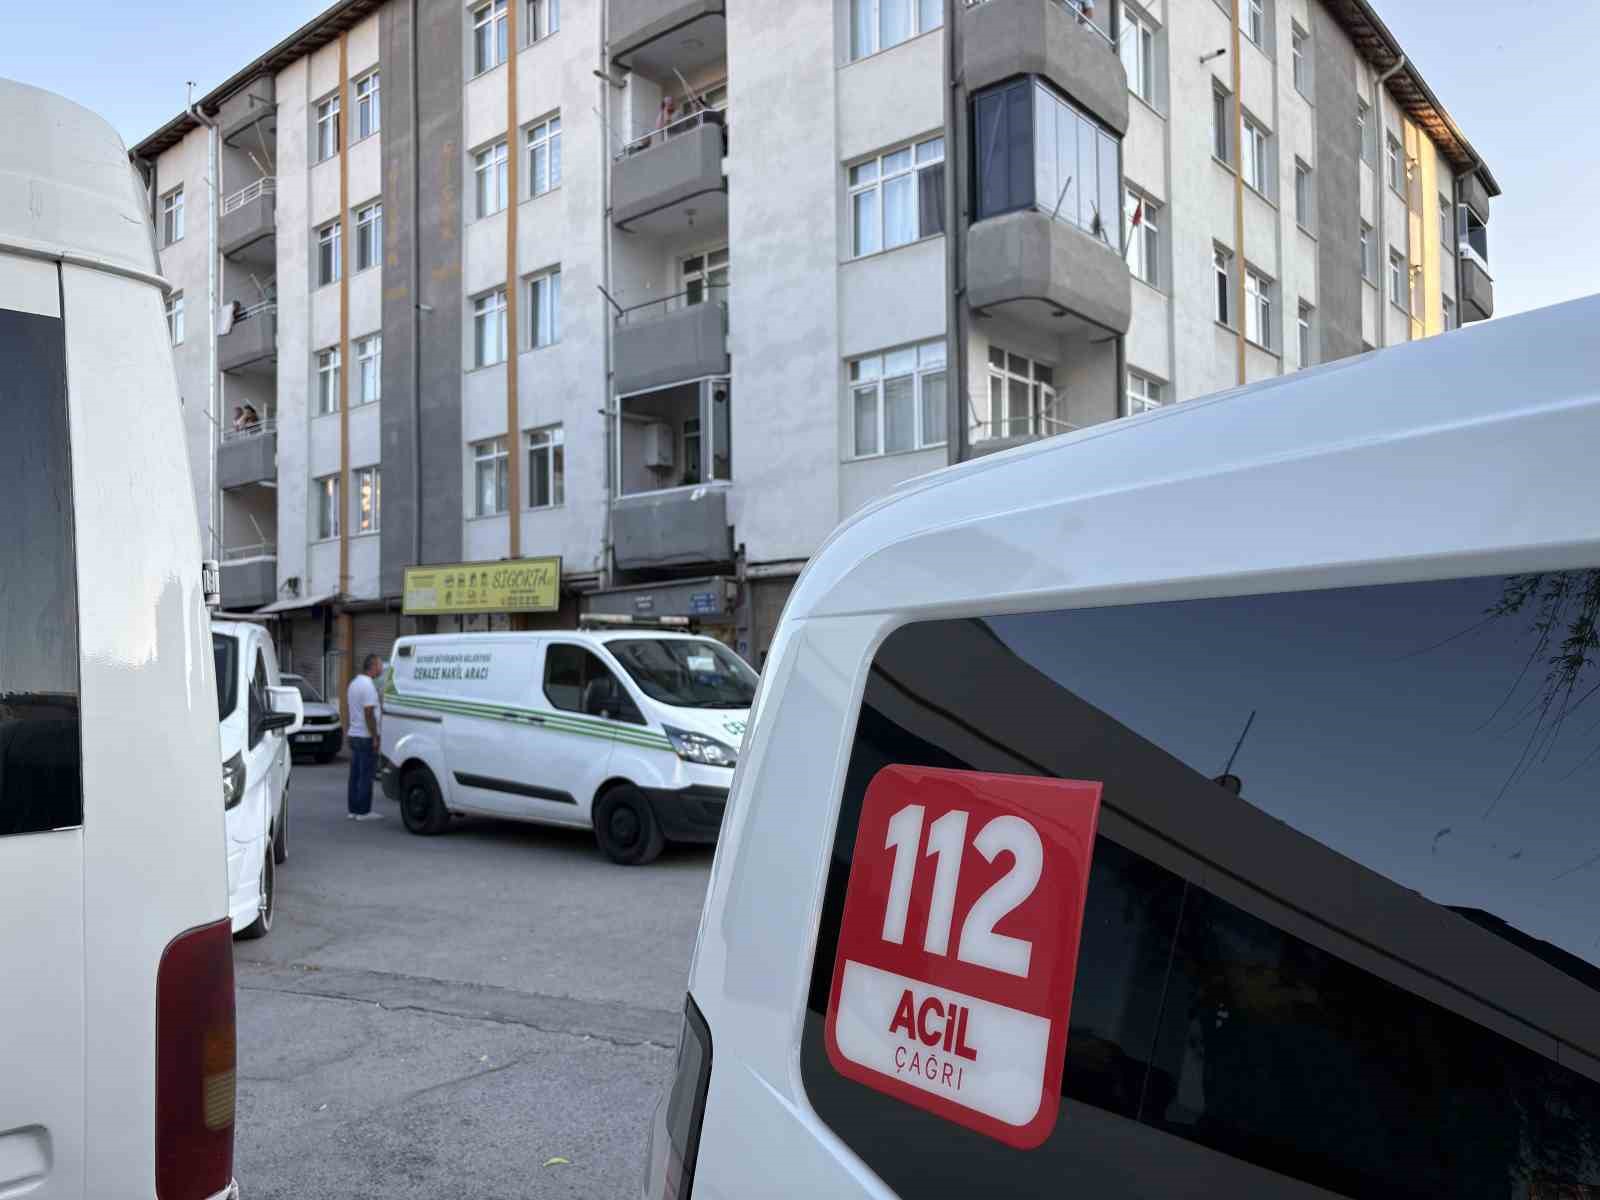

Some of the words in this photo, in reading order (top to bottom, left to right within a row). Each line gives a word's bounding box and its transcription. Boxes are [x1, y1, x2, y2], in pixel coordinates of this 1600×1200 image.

[881, 804, 1043, 978] 112
[889, 989, 977, 1061] ACİL
[895, 1046, 963, 1090] ÇAĞRI
